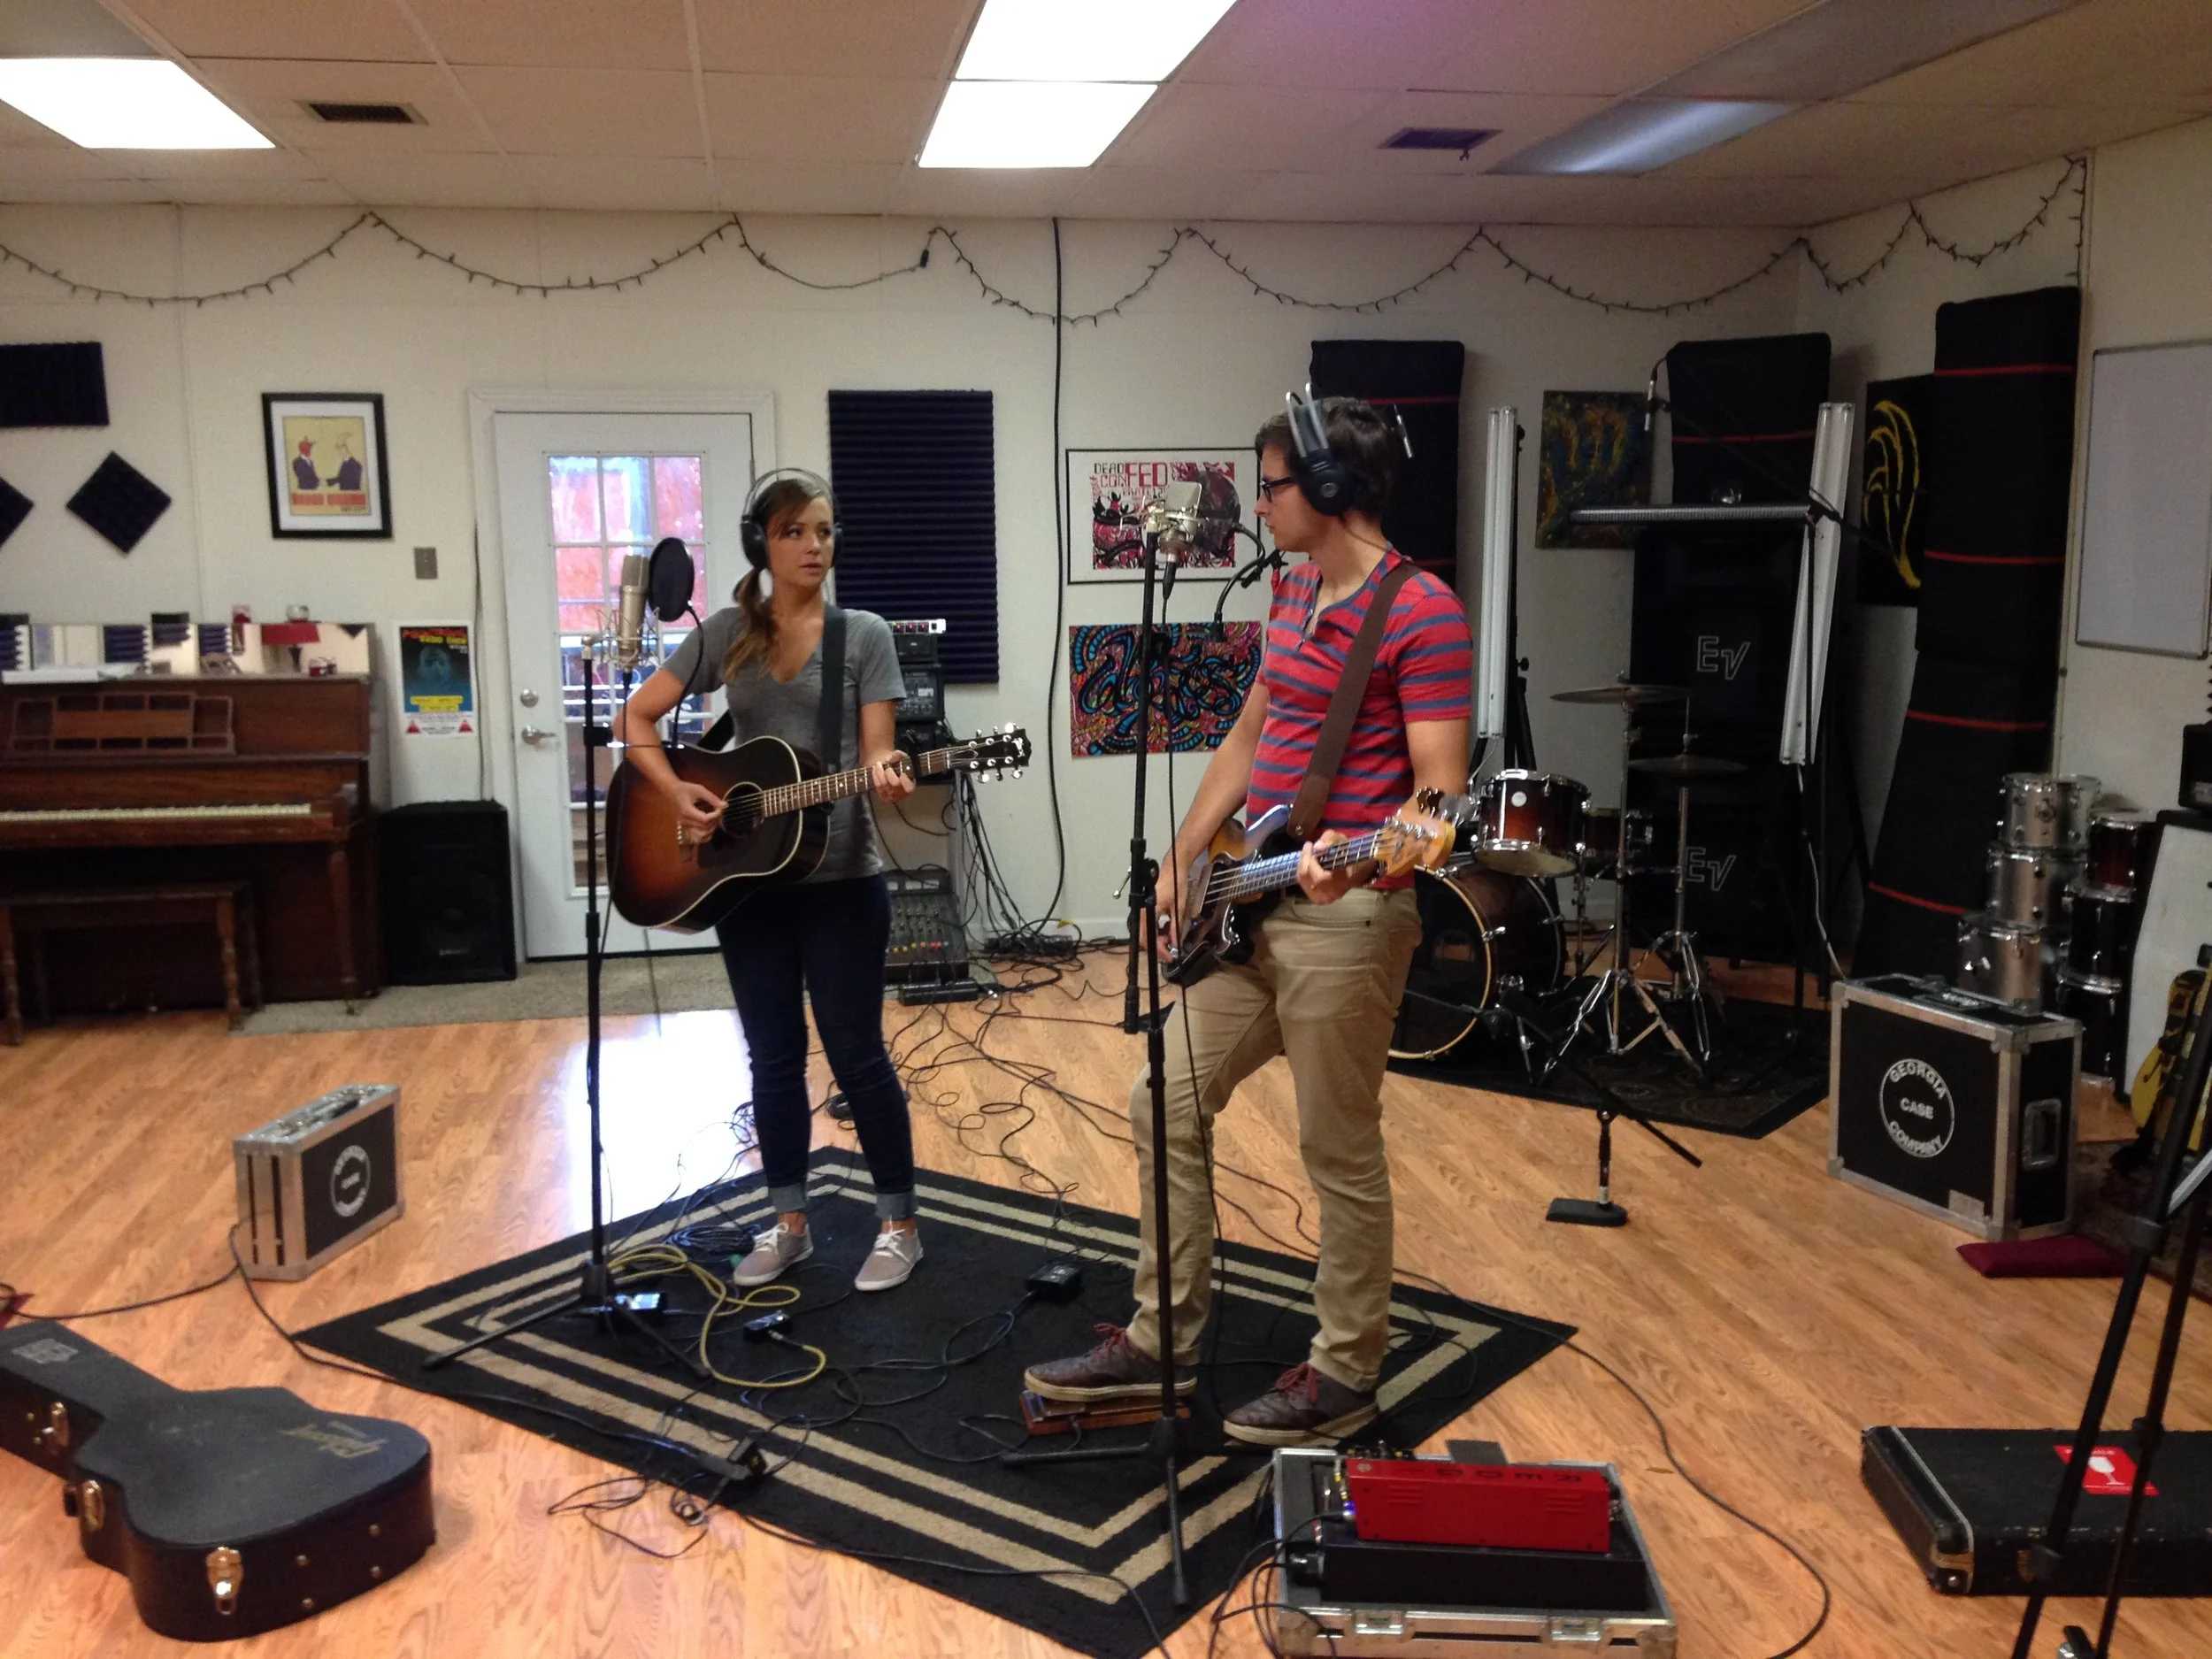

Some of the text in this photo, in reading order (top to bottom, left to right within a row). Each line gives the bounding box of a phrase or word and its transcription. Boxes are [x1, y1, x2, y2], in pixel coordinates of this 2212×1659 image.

[1094, 463, 1125, 474] DEAD
[1125, 462, 1168, 488] FED
[1890, 1062, 1947, 1100] GEORGIA
[1900, 1097, 1933, 1119] CASE
[1889, 1121, 1942, 1155] COMPANY
